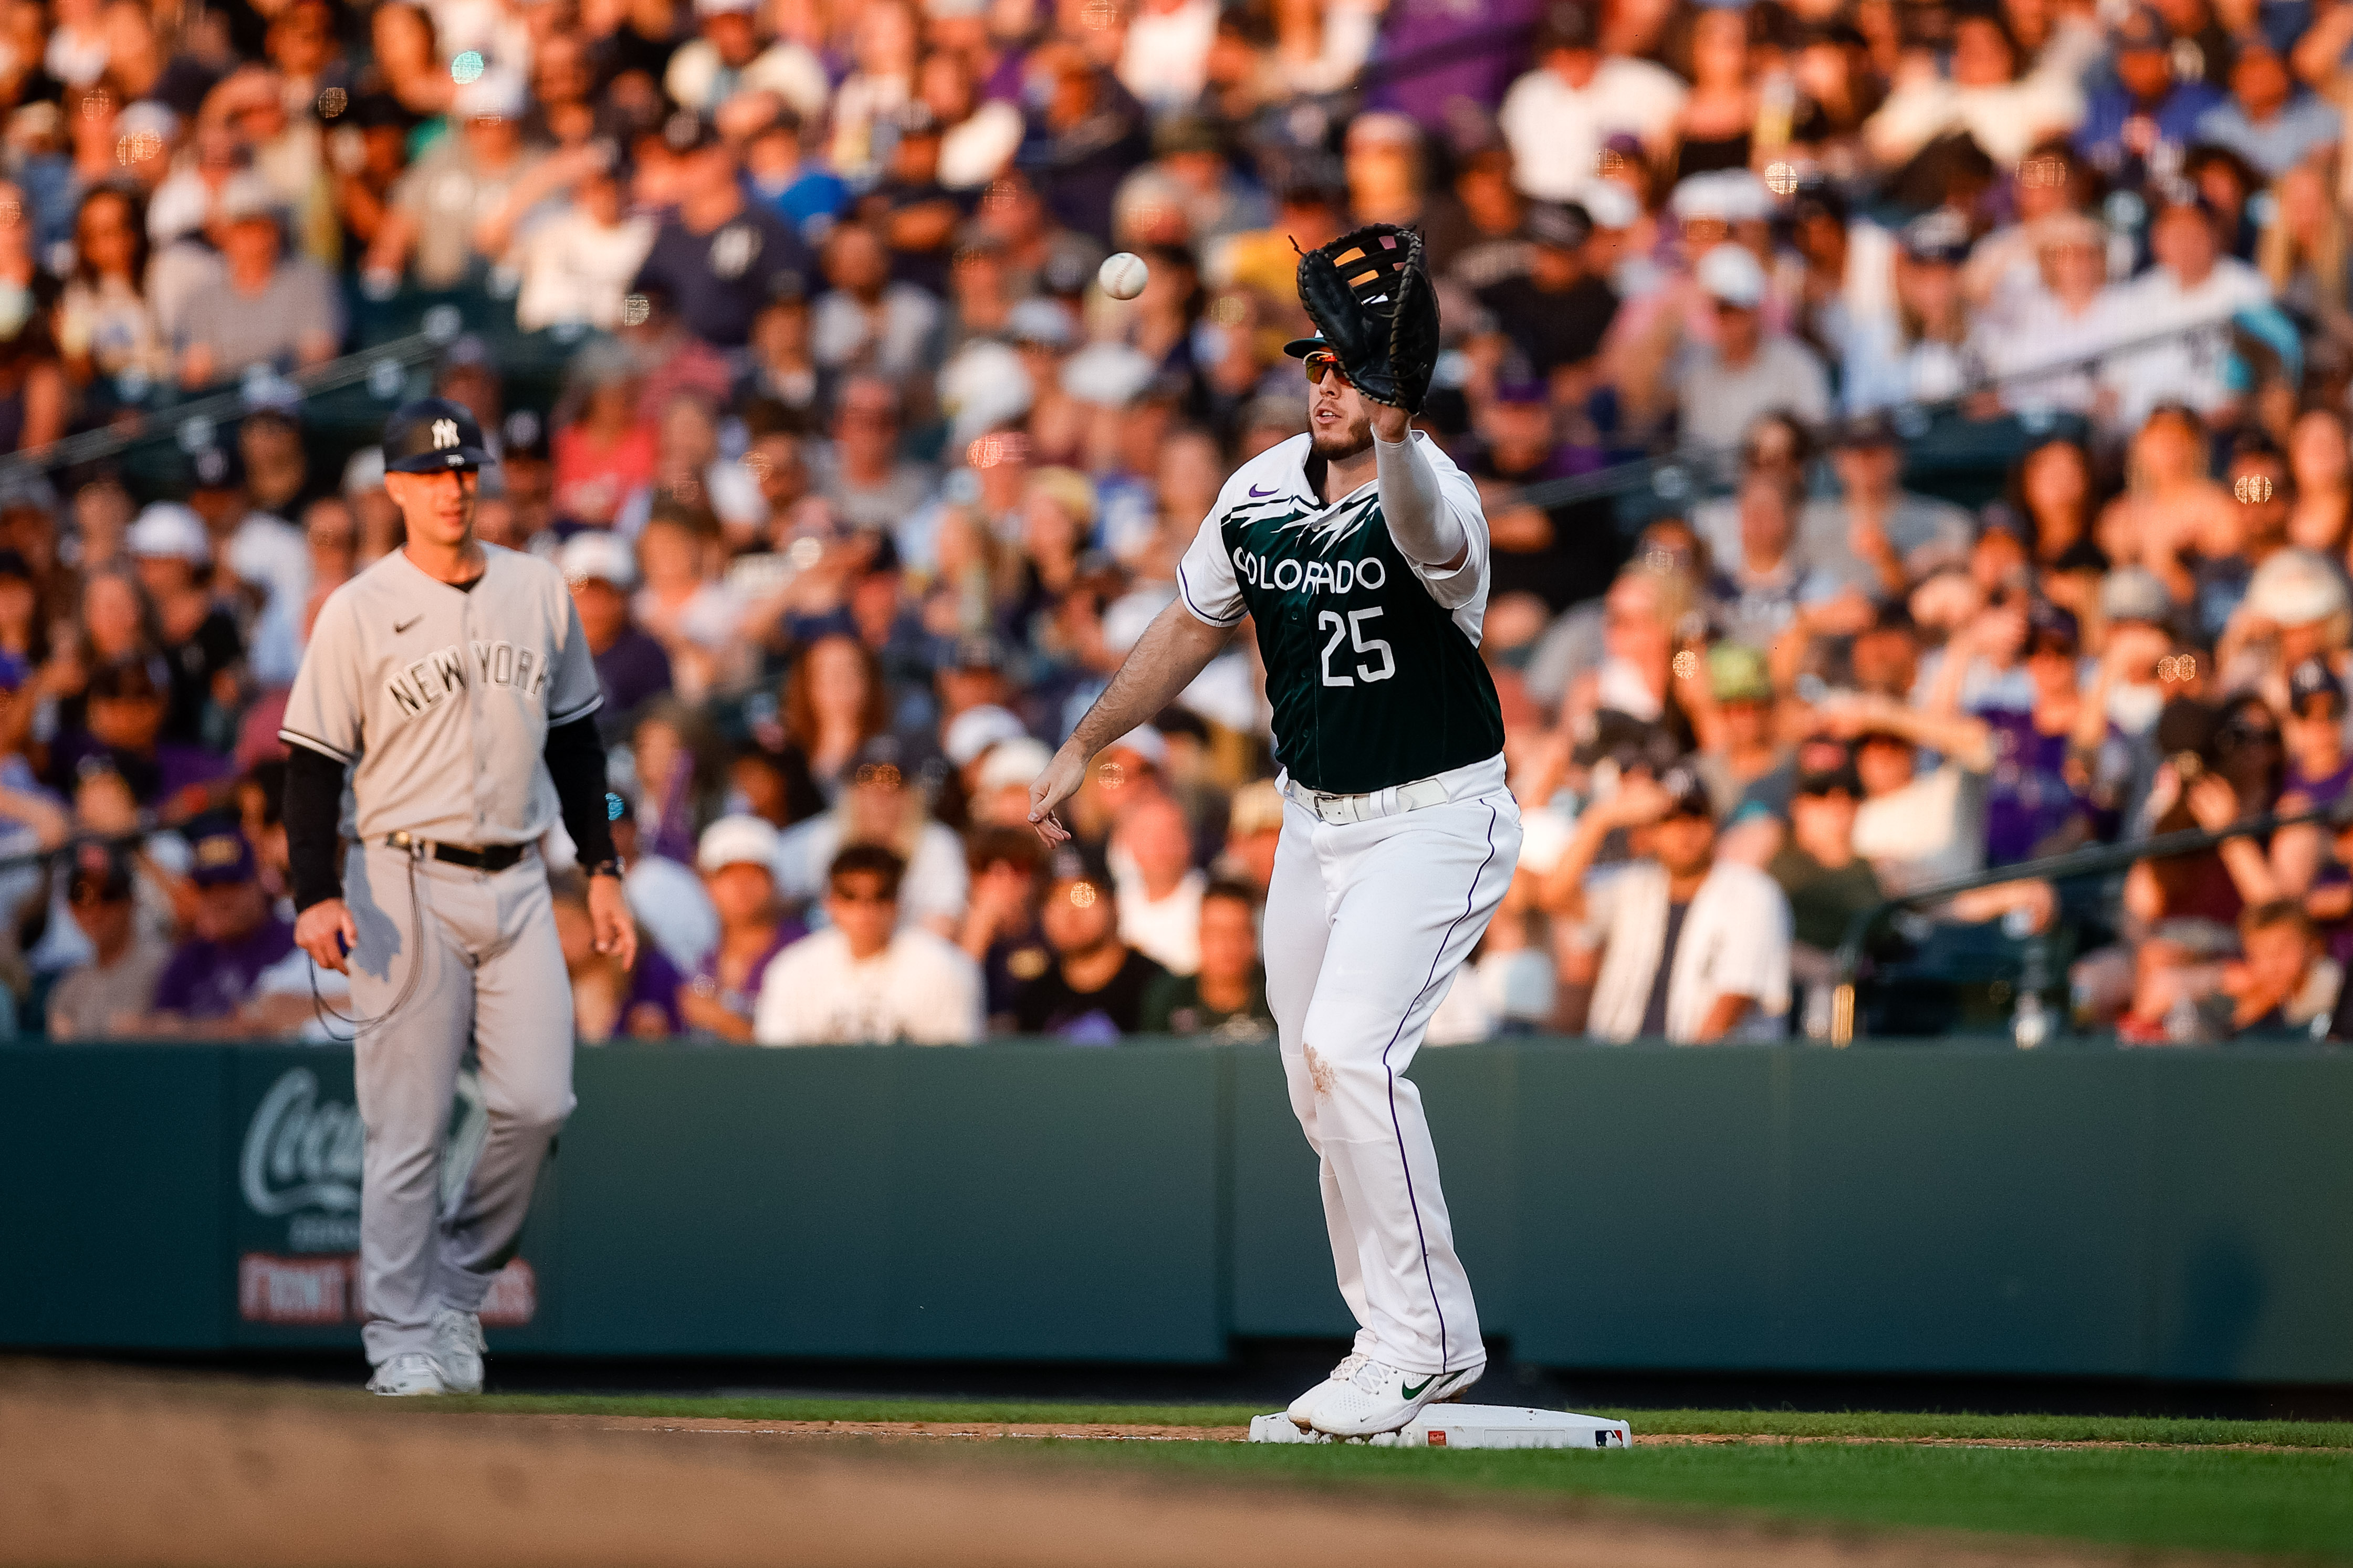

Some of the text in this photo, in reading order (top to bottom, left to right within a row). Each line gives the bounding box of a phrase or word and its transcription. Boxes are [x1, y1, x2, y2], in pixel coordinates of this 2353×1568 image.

[1233, 546, 1386, 595] COLORADO
[383, 644, 468, 719] NEW
[1319, 606, 1396, 687] 25
